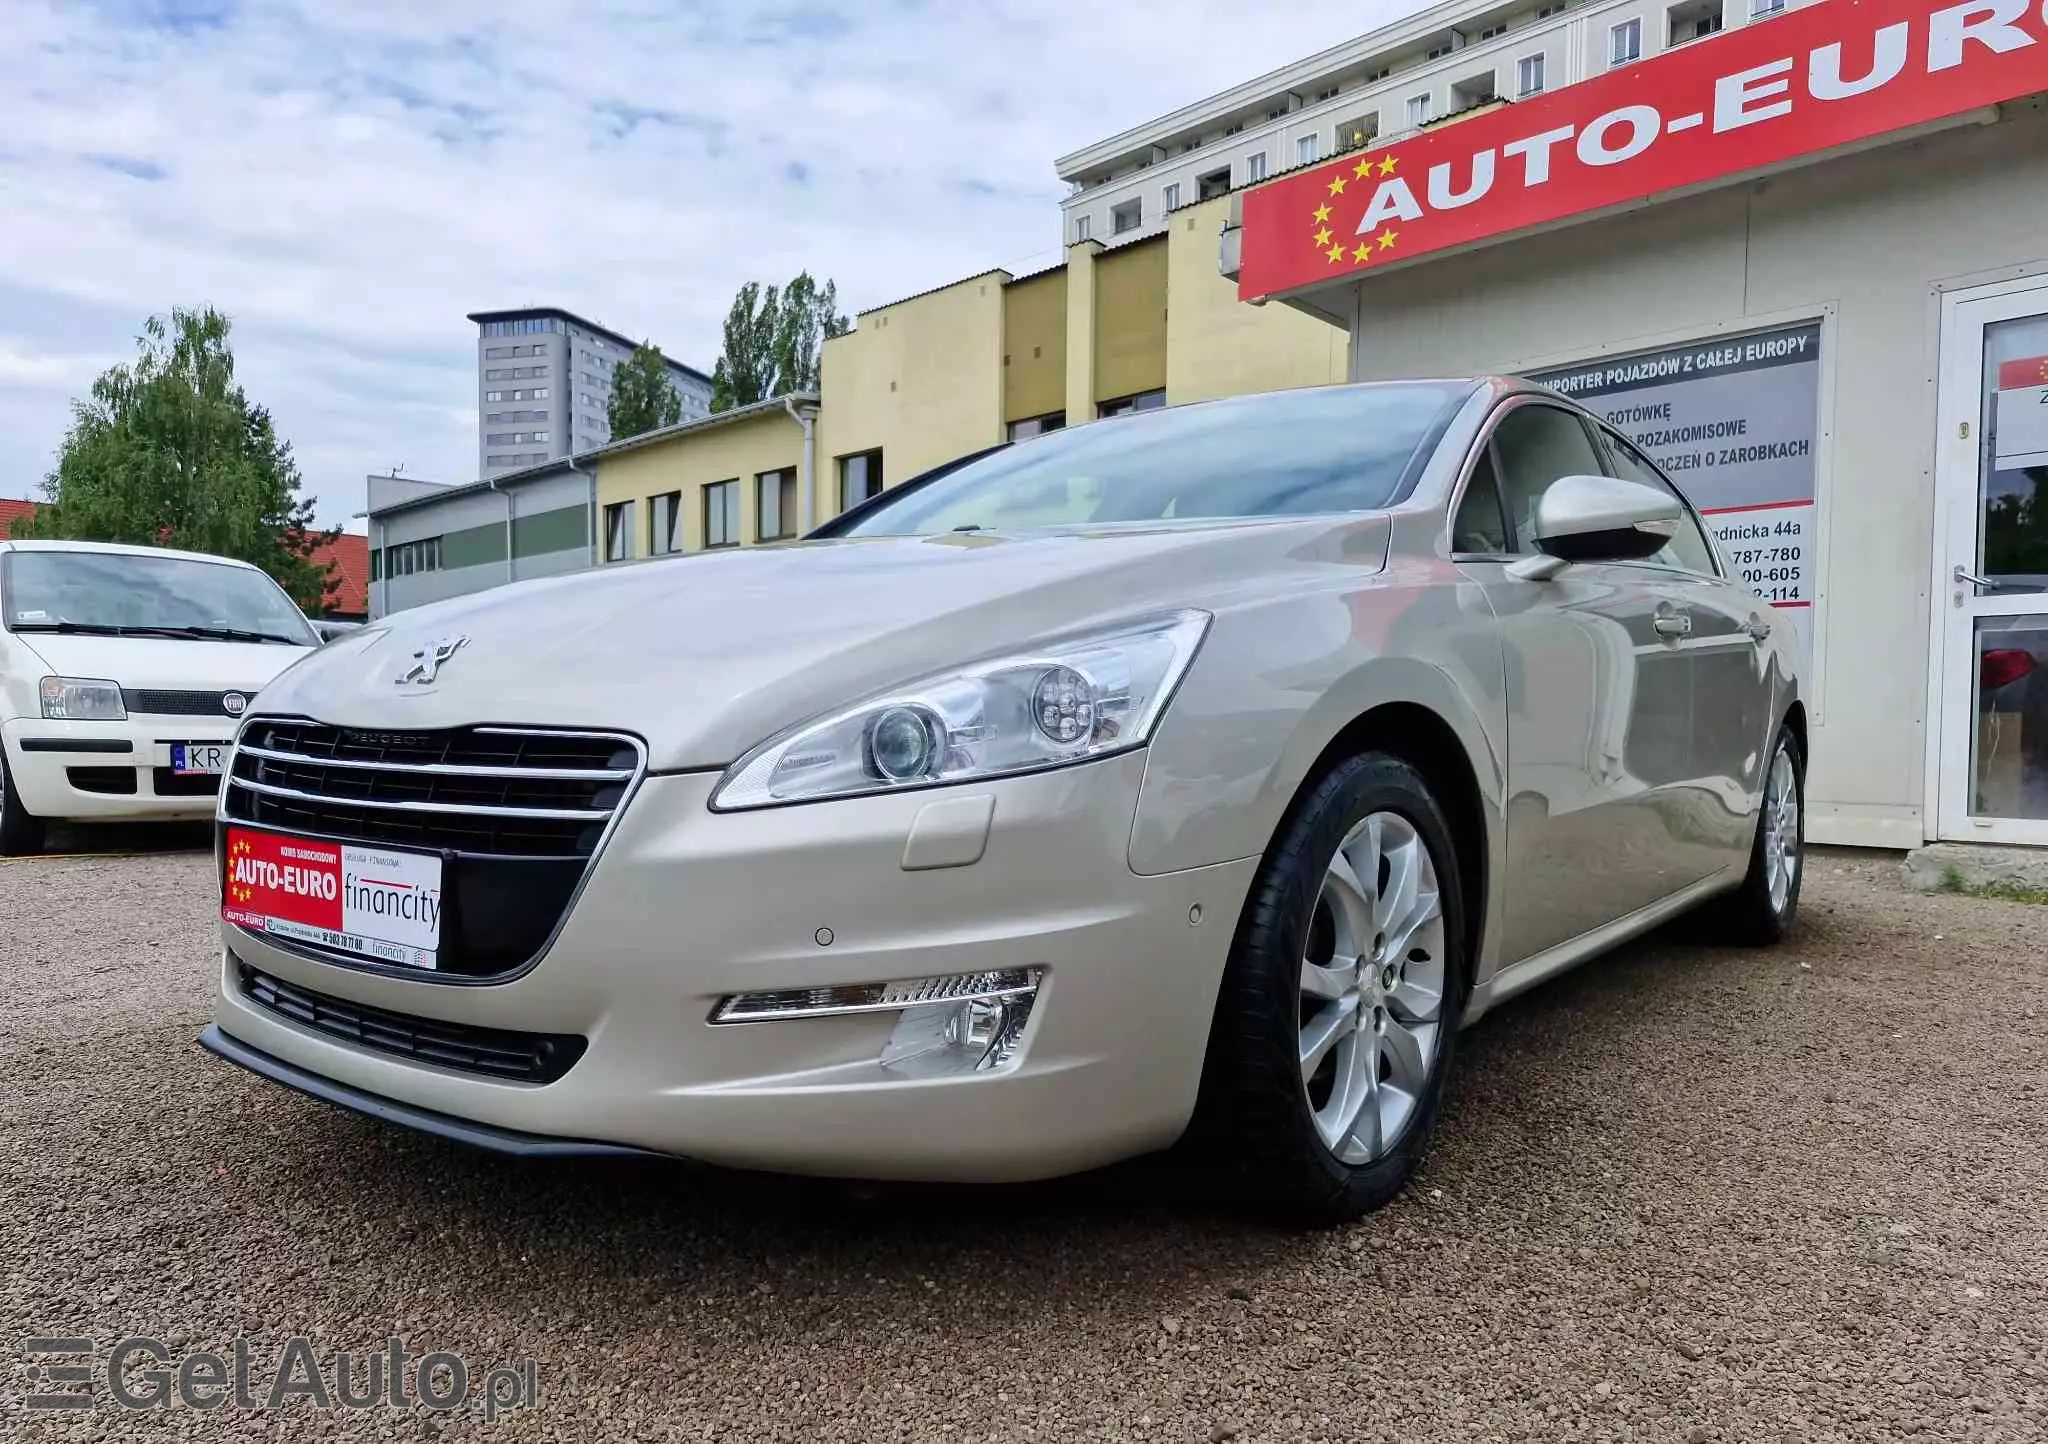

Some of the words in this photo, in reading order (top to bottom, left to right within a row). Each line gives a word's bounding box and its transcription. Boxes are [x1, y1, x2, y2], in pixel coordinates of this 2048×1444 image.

[1354, 0, 2048, 236] AUTO-EUR
[1606, 357, 1680, 385] POJAZDÓW
[1683, 355, 1693, 372] Z
[1696, 346, 1742, 370] CAŁEJ
[1746, 335, 1808, 361] EUROPY
[1637, 419, 1747, 447] POZAKOMISOWE
[1705, 451, 1715, 467] O
[1719, 439, 1809, 466] ZAROBKACH
[1774, 521, 1801, 536] 44a
[191, 747, 221, 767] KR
[235, 857, 337, 901] AUTO-EURO
[344, 872, 441, 933] financity
[227, 911, 264, 926] AUTO-EURO
